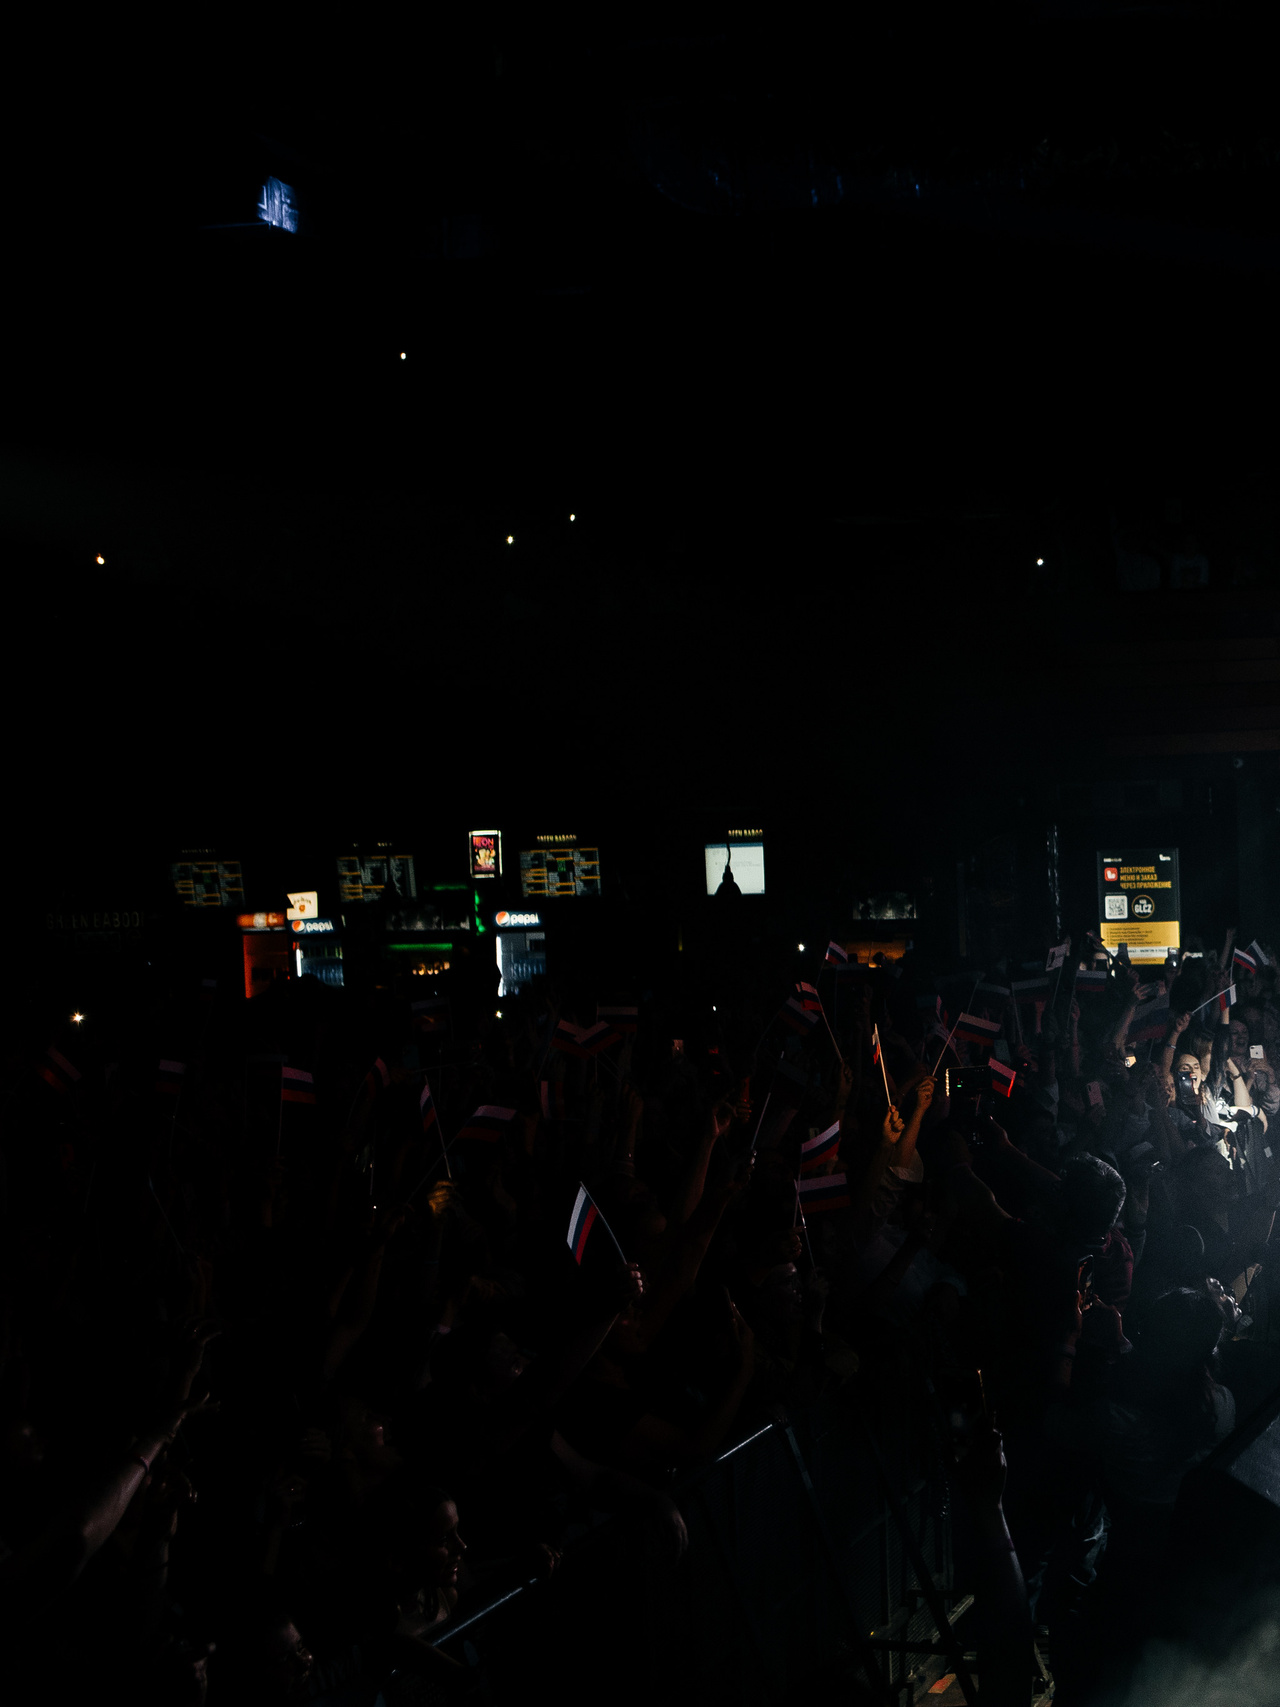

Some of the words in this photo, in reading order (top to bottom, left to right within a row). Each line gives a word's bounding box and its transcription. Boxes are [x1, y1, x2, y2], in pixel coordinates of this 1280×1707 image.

[1141, 873, 1158, 881] ЗАКАЗ
[1137, 881, 1172, 889] ПРИЛОЖЕНИЕ
[510, 912, 539, 926] pepsi
[305, 920, 334, 933] pepsi
